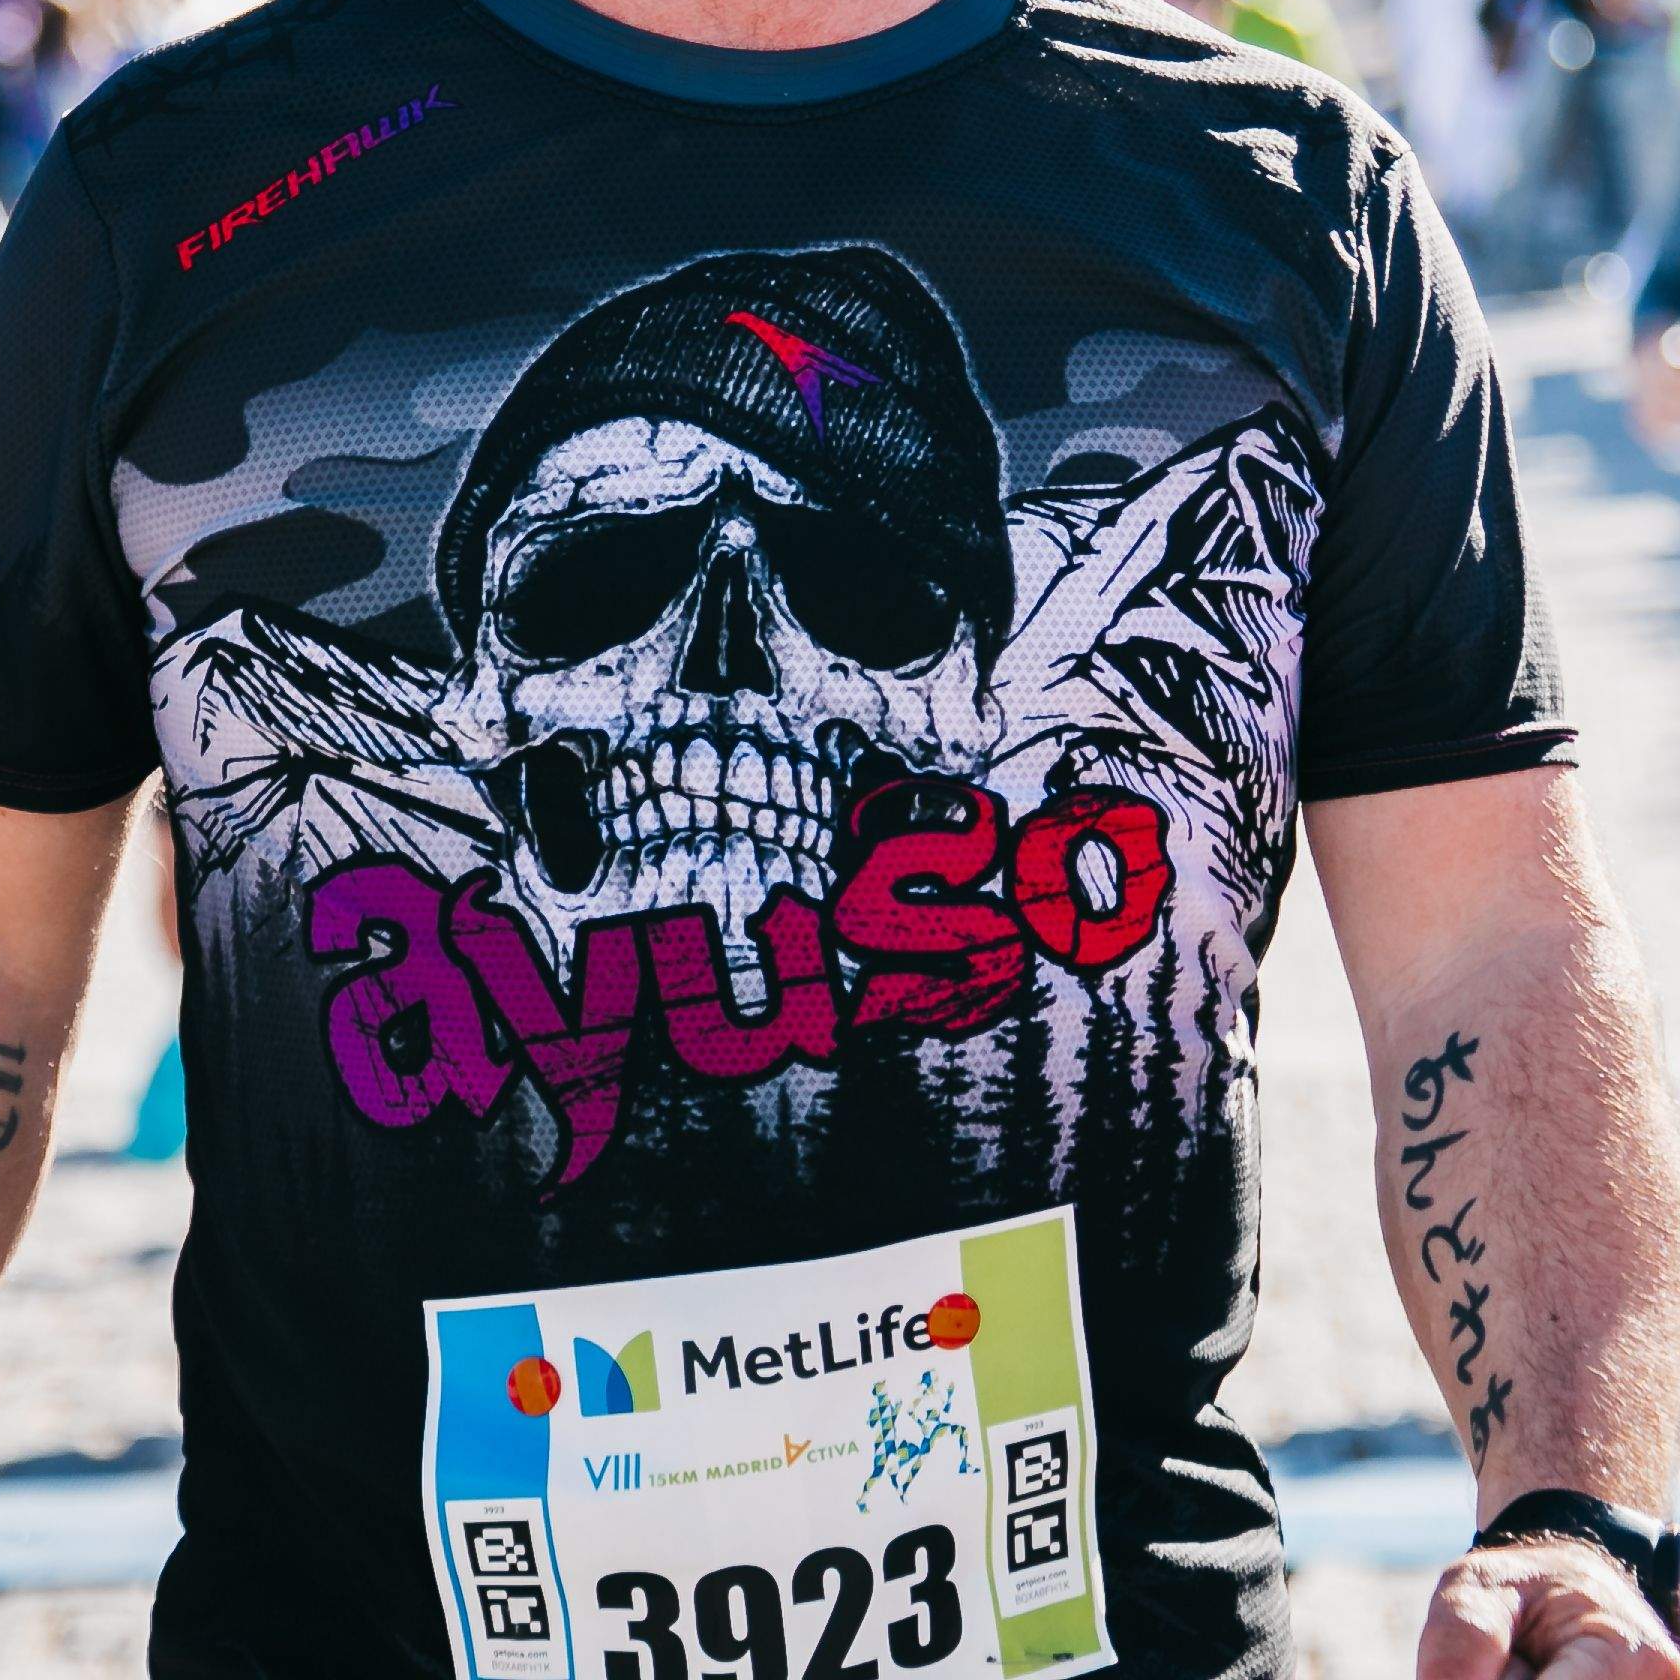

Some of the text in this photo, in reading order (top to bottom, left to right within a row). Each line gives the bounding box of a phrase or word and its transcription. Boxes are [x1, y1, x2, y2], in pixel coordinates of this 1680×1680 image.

[175, 83, 461, 272] FIREHAWK
[308, 776, 1178, 1204] ayuso
[681, 1303, 935, 1396] MetLife
[582, 1452, 642, 1493] VIII
[648, 1469, 699, 1488] 15KM
[705, 1456, 784, 1482] MADRID
[595, 1523, 963, 1680] 3923
